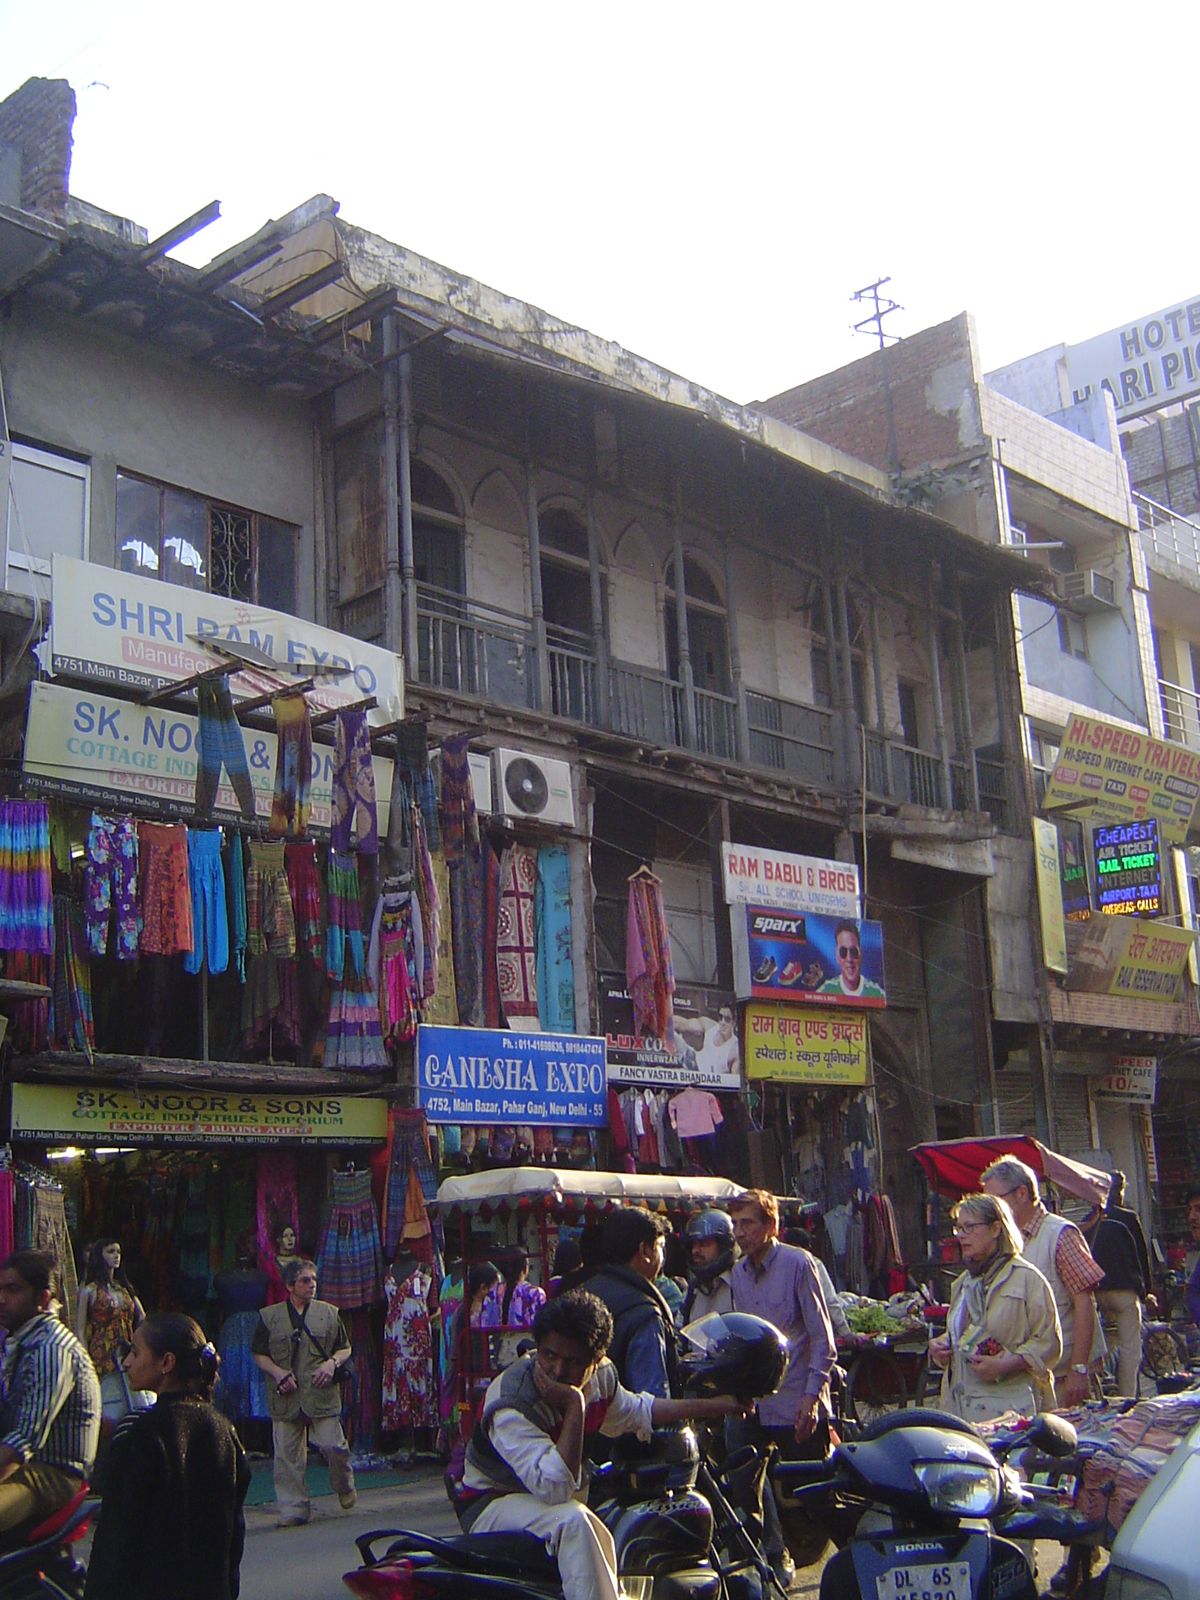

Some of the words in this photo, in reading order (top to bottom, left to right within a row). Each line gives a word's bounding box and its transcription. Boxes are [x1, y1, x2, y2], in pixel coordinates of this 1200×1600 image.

[92, 592, 184, 644] SHRI
[287, 639, 378, 694] EXPO
[73, 701, 130, 742] SK.
[249, 740, 271, 771] &
[1069, 718, 1142, 760] HI-SPEED
[65, 736, 159, 771] COTTAGE
[1063, 746, 1102, 768] HI-SPEED
[1104, 756, 1143, 779] INTERNET
[1144, 768, 1164, 785] CAFE
[1098, 824, 1153, 846] CHEAPEST
[1118, 840, 1154, 856] TICKET
[728, 854, 759, 879] RAM
[763, 860, 802, 885] BABU
[807, 867, 815, 887] &
[818, 868, 857, 894] BROS
[1098, 858, 1121, 874] RAIL
[1121, 852, 1155, 870] TICKET
[1137, 898, 1159, 911] CALLS
[753, 916, 802, 934] sparx
[605, 1032, 645, 1051] LUX
[752, 1015, 774, 1034] राम
[779, 1018, 804, 1046] बाबू
[424, 1054, 539, 1092] GANESHA
[545, 1060, 603, 1094] EXPO
[619, 1066, 646, 1080] FANCY
[647, 1069, 679, 1082] VASTRA
[680, 1072, 722, 1085] BHANDAAR
[1133, 1067, 1153, 1078] CAFE
[75, 1088, 129, 1110] SK.
[139, 1093, 228, 1112] NOOR
[238, 1098, 257, 1114] &
[266, 1098, 343, 1116] SONS
[427, 1097, 451, 1114] 4752,
[453, 1099, 473, 1112] Main
[475, 1100, 501, 1116] Bazar,
[502, 1102, 526, 1114] Pahar
[549, 1105, 567, 1116] New
[568, 1105, 588, 1117] Delhi
[71, 1108, 157, 1122] COTTAGE
[161, 1110, 259, 1124] INDUSTRIES
[263, 1114, 345, 1126] EMPORIUM
[211, 1125, 262, 1134] BUYING
[895, 1543, 945, 1553] HONDA
[894, 1569, 914, 1589] DL
[931, 1566, 952, 1586] 6S
